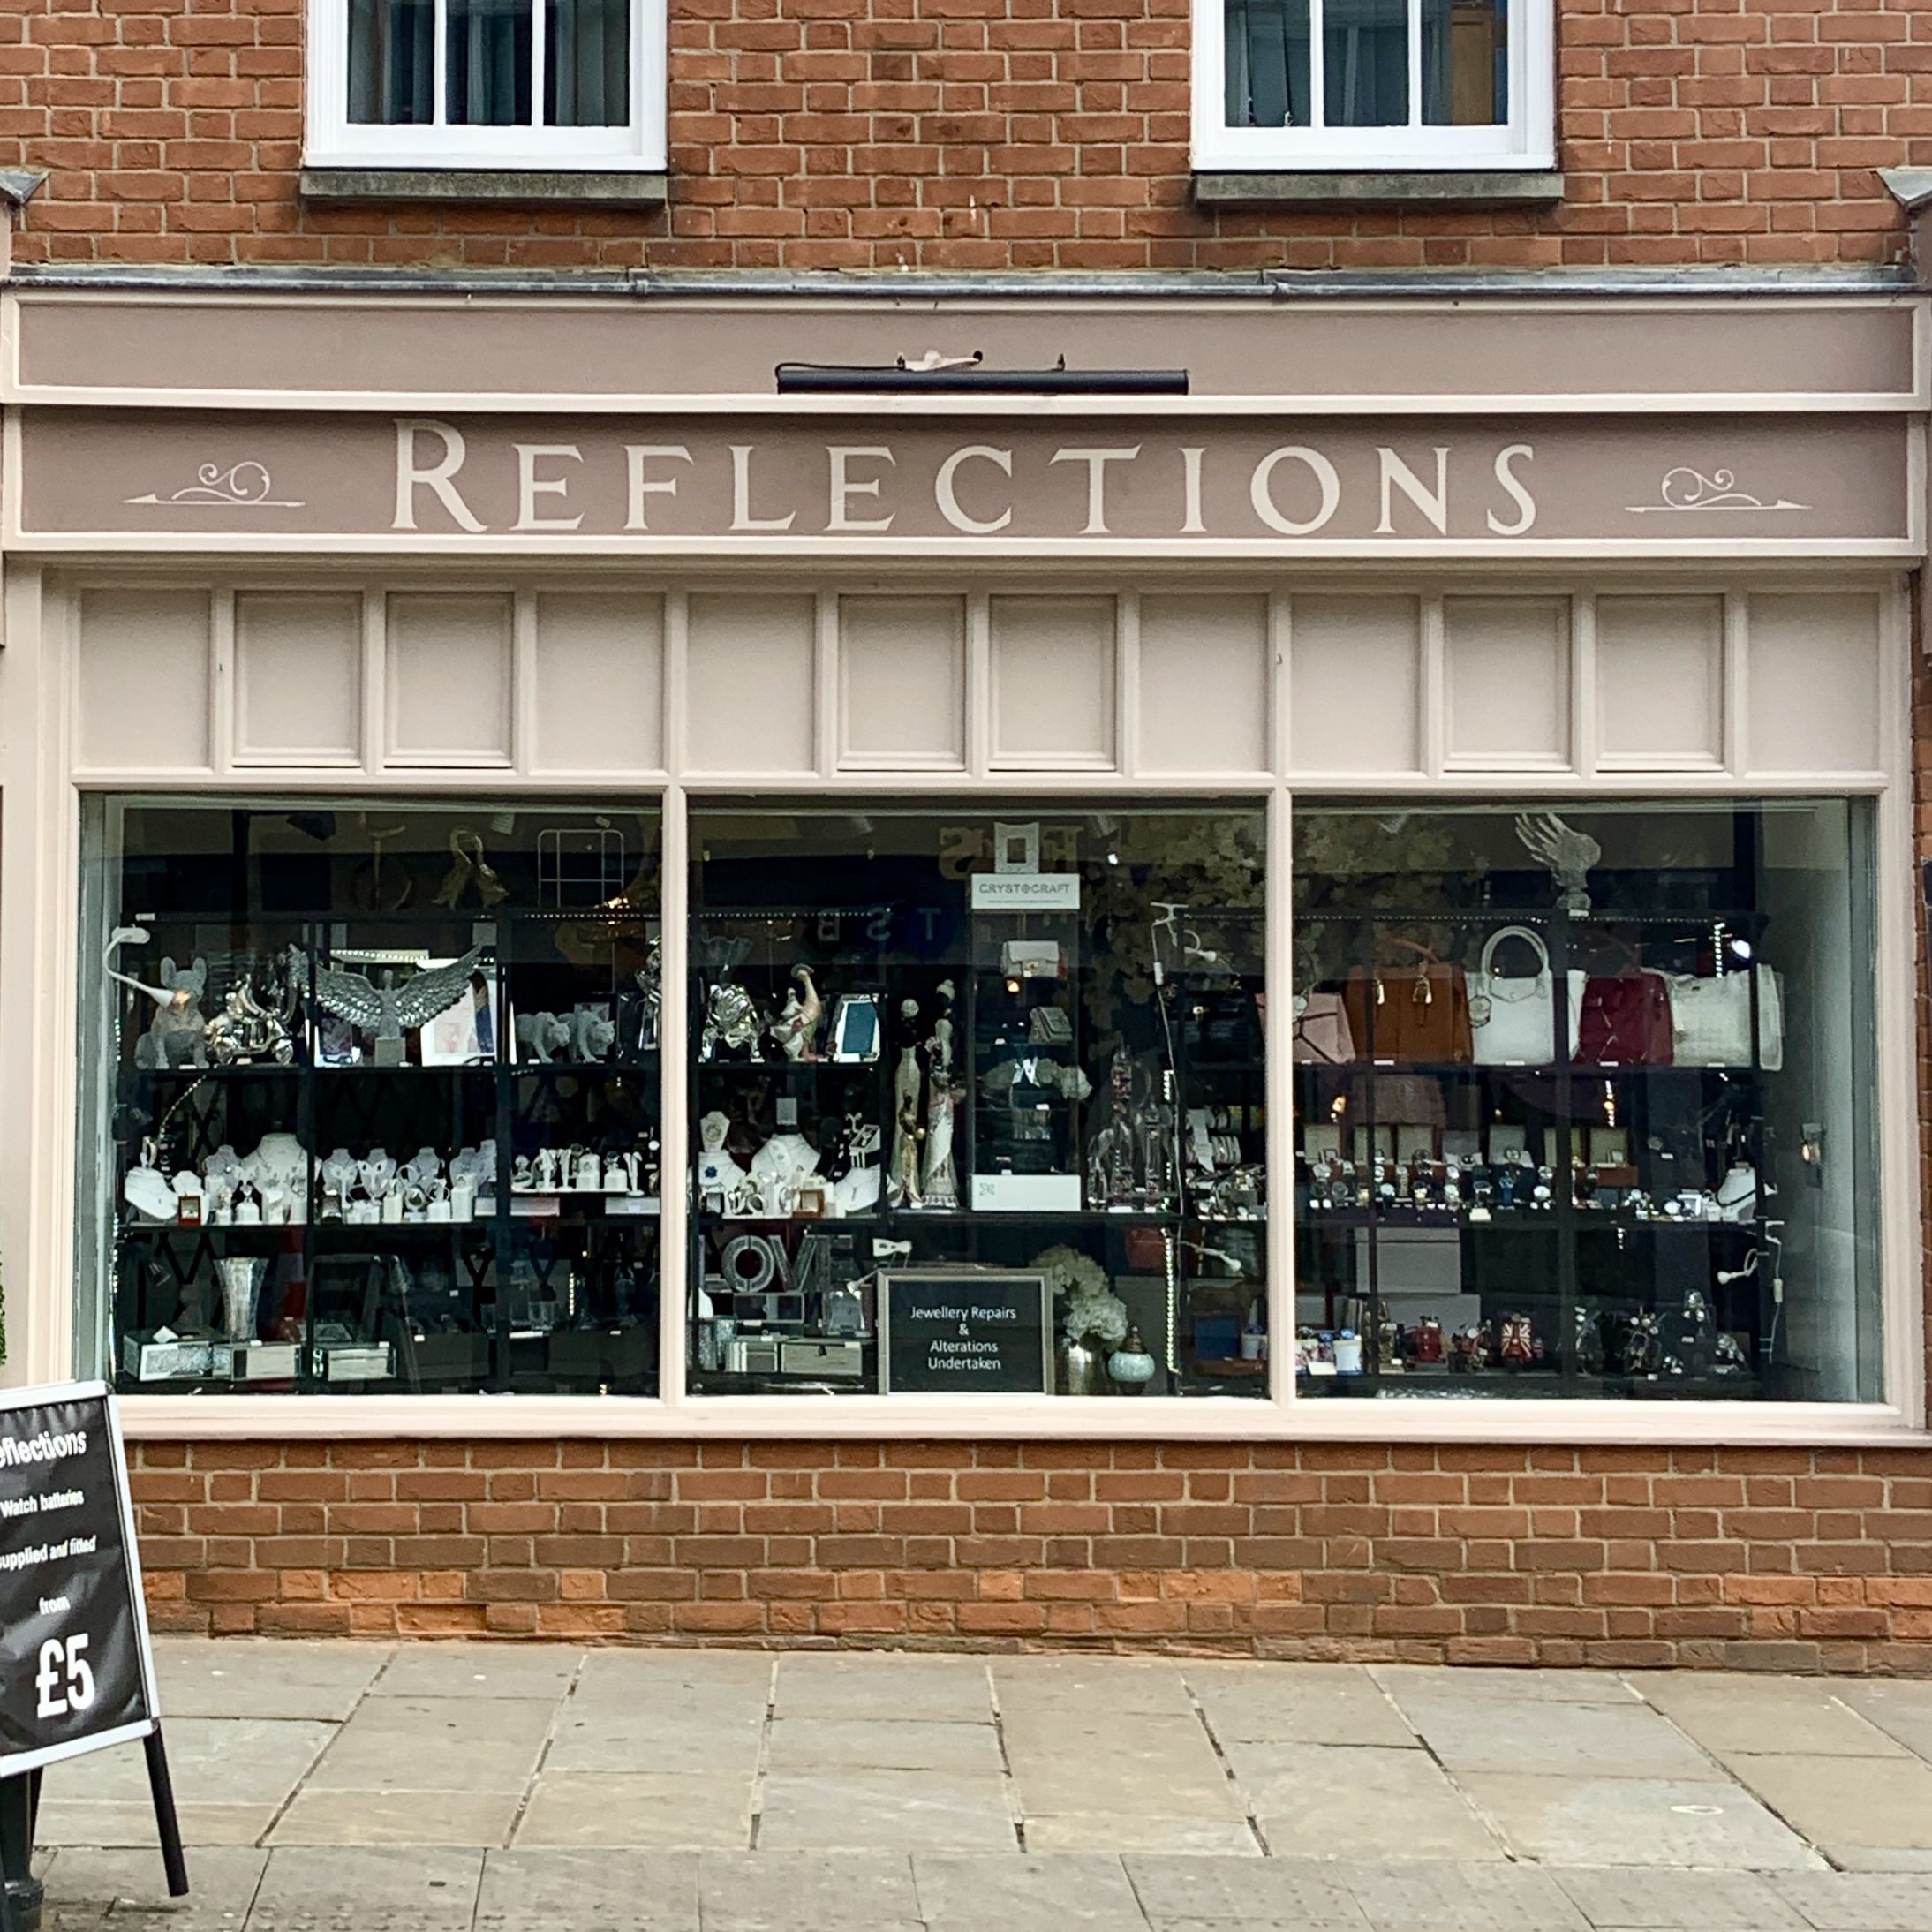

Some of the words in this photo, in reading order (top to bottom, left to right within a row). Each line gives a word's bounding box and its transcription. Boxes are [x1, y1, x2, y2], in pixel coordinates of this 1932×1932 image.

[390, 419, 1536, 535] REFLECTIONS
[910, 1306, 968, 1321] Jewellery
[971, 1306, 1016, 1321] Repairs
[958, 1323, 970, 1336] &
[930, 1340, 999, 1353] Alterations
[928, 1357, 1001, 1370] Undertaken
[0, 1495, 38, 1518] Watch
[40, 1489, 85, 1511] batteries
[49, 1539, 69, 1560] and
[70, 1534, 97, 1555] fitted
[39, 1596, 71, 1615] from
[35, 1633, 95, 1718] £5
